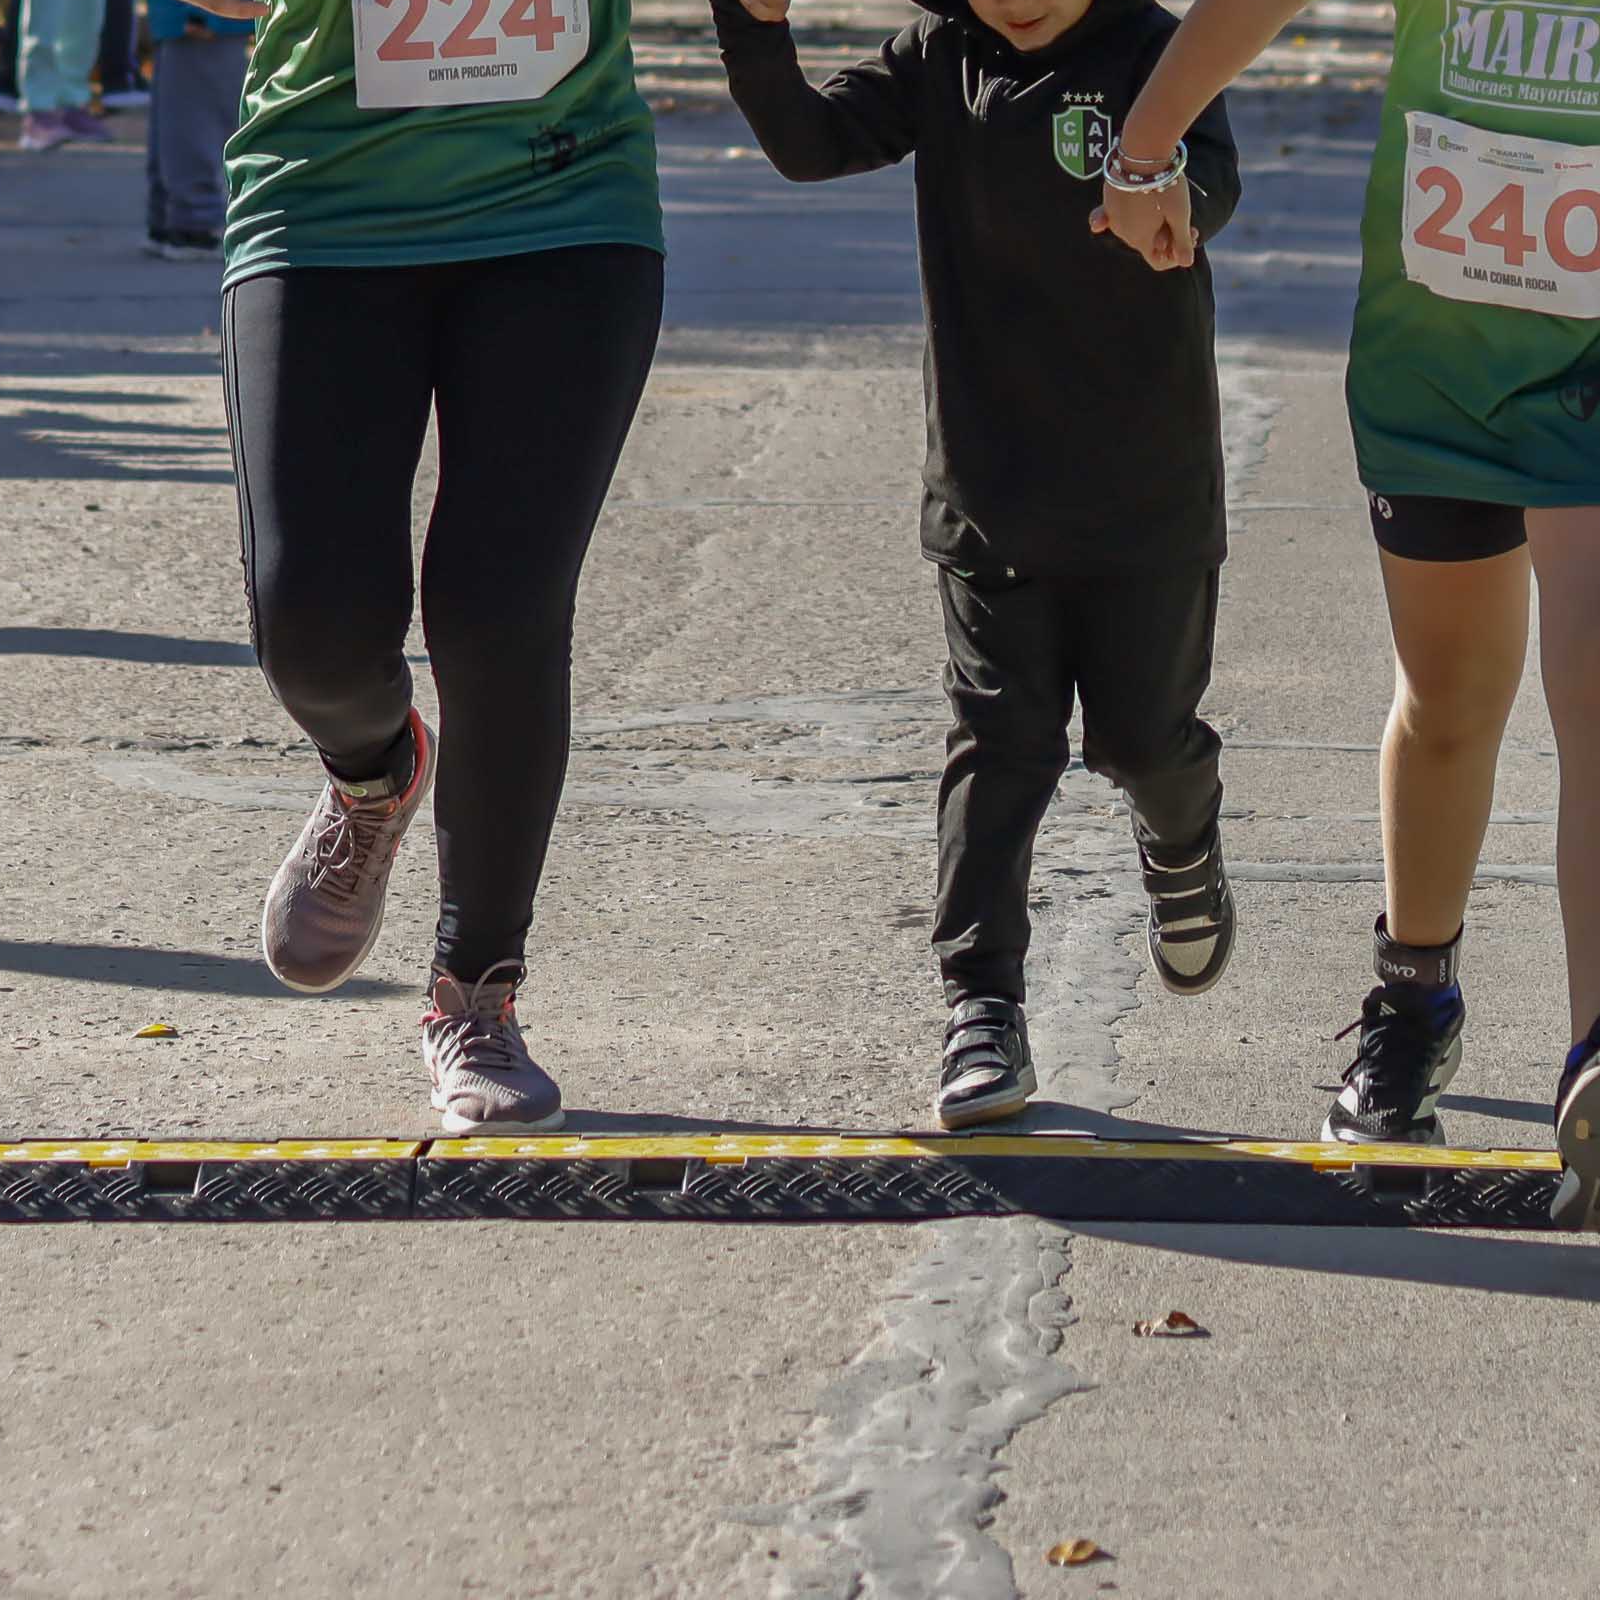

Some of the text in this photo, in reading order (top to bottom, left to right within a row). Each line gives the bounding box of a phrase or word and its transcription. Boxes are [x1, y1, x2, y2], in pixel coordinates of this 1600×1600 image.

[428, 63, 518, 81] CINTIA PROCACITTO
[1448, 70, 1513, 97] Almacenes
[1518, 83, 1600, 105] Mayoristas
[1462, 266, 1558, 293] ALMA COMBA ROCHA
